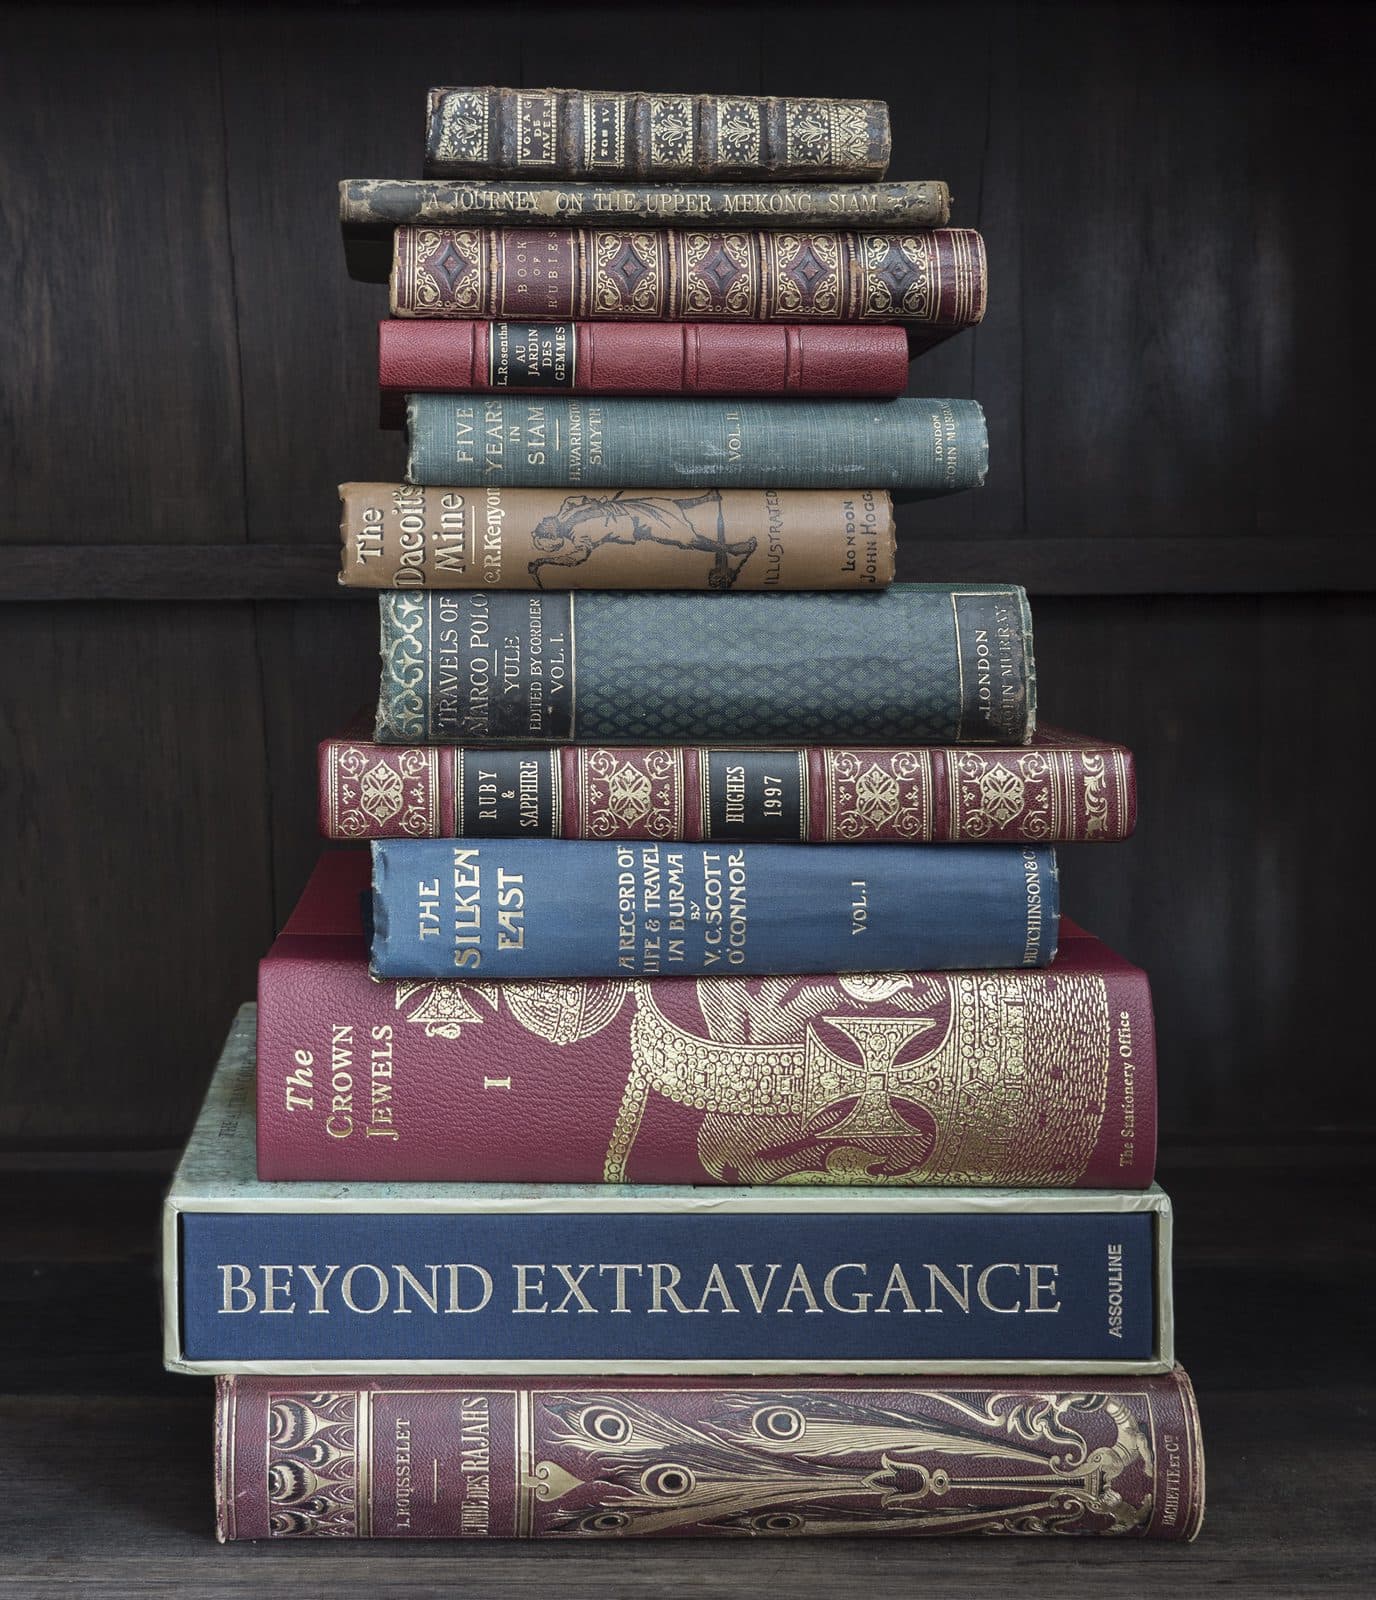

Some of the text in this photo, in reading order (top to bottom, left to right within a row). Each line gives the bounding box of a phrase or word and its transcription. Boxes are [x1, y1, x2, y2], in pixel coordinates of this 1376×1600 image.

[533, 120, 542, 137] DE
[427, 192, 441, 210] A
[450, 190, 540, 210] JOURNEY
[555, 192, 584, 212] ON
[593, 192, 638, 211] THE
[646, 193, 713, 212] UPPER
[828, 193, 878, 212] SIAM
[517, 241, 528, 293] BOOK
[533, 257, 541, 276] OF
[547, 231, 558, 308] RUBIES
[516, 345, 526, 363] AU
[528, 329, 540, 376] JARDIN
[542, 340, 553, 367] DES
[555, 326, 566, 381] GEMMES
[456, 407, 474, 463] FIVE
[485, 400, 503, 475] YEARS
[510, 426, 521, 442] IN
[527, 406, 545, 465] SIAM
[588, 407, 602, 465] SMYTH
[931, 415, 944, 462] LONDON
[356, 507, 384, 565] The
[392, 485, 425, 587] Dacoit's
[432, 493, 464, 574] Mine
[764, 490, 784, 585] ILLUSTRATED
[841, 501, 856, 572] LONDON
[860, 541, 877, 583] JOHN
[438, 596, 459, 727] TRAVELS OF
[468, 593, 489, 737] MARCO POLO
[503, 634, 521, 695] YULE
[529, 599, 543, 731] EDITED BY CORDIER
[975, 630, 991, 710] LONDON
[478, 770, 497, 819] RUBY
[500, 790, 515, 799] &
[519, 760, 538, 827] SAPPHIRE
[726, 766, 745, 823] HUGHES
[763, 775, 782, 816] 1997
[418, 878, 440, 941] THE
[454, 848, 481, 969] SILKEN
[497, 867, 525, 950] EAST
[617, 845, 636, 970] A RECORD OF
[643, 842, 661, 973] LIFE & TRAVEL
[667, 854, 685, 961] IN BURMA
[690, 900, 701, 921] BY
[726, 849, 747, 965] O'CONNOR
[286, 1049, 314, 1112] The
[326, 1023, 353, 1138] CROWN
[366, 1024, 400, 1141] JEWELS
[484, 1075, 511, 1090] I
[1117, 1010, 1136, 1167] The Stationery Office
[216, 1263, 1061, 1315] BEYOND EXTRAVAGANCE
[1106, 1243, 1123, 1338] ASSOULINE
[461, 1396, 490, 1473] RAJAHS
[1169, 1454, 1181, 1467] ET
[466, 1474, 490, 1500] DES
